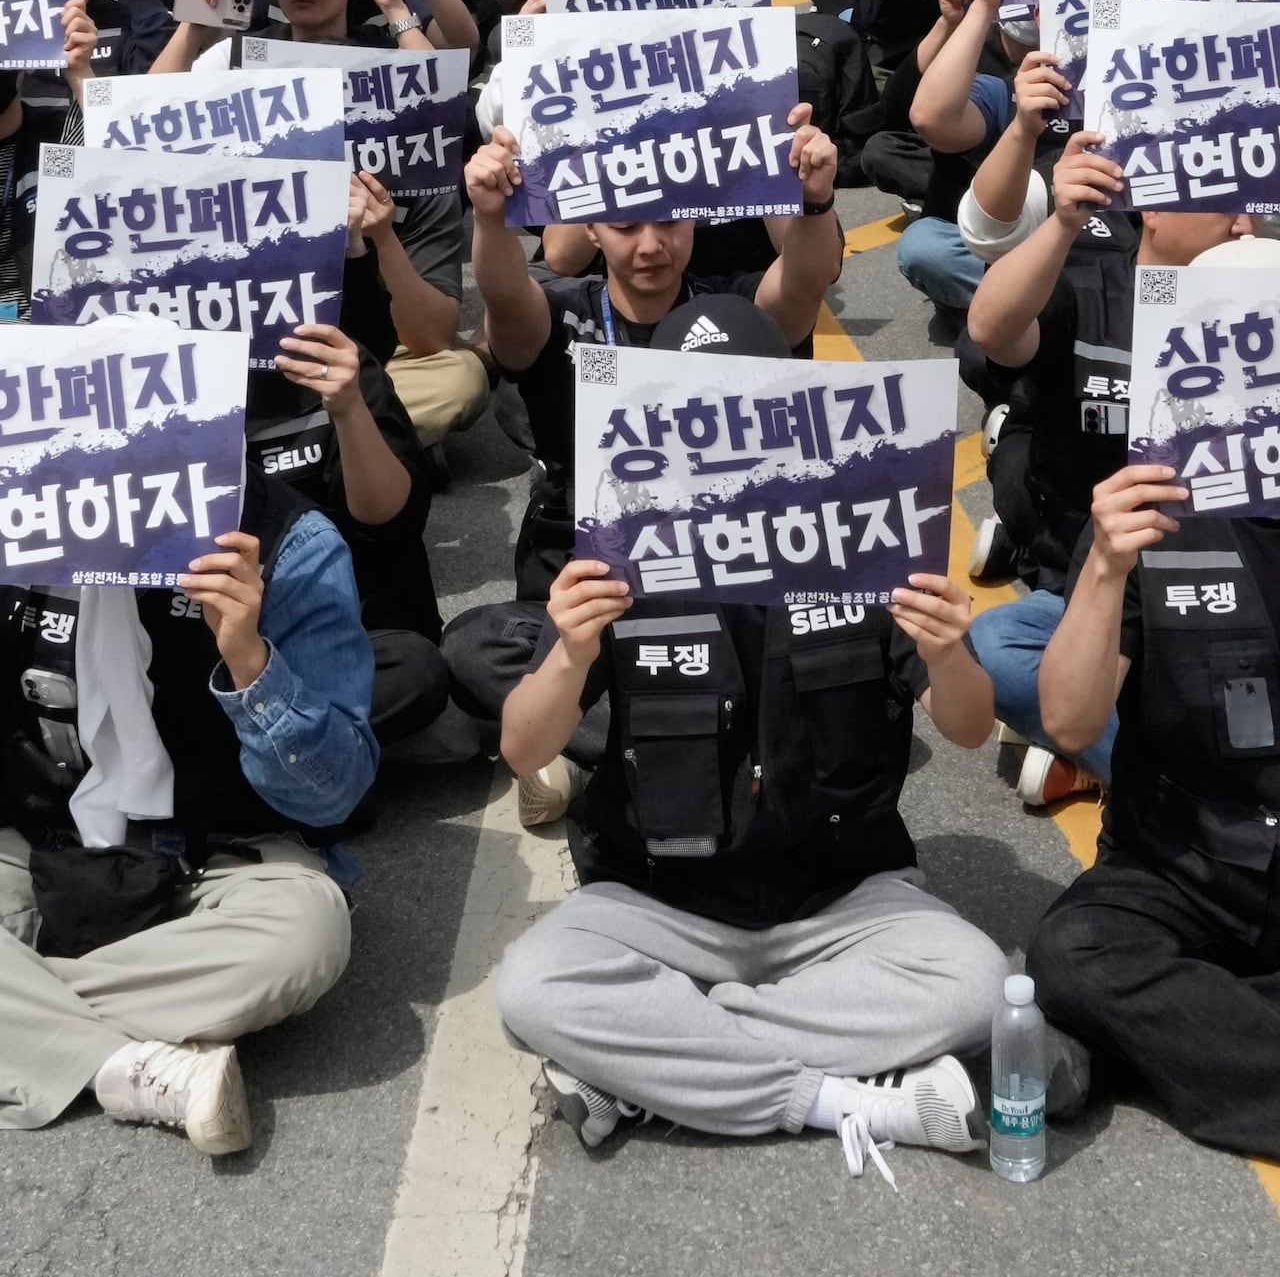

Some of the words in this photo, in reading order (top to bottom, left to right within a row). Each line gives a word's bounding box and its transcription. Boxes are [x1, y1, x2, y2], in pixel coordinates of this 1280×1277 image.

[520, 17, 760, 125] 상한폐지
[548, 113, 795, 221] 실현하자
[55, 171, 309, 260] 상한폐지
[671, 206, 744, 218] 삼성전자노동조합
[745, 203, 801, 216] 공동투쟁본부
[681, 331, 729, 352] adidas
[599, 374, 907, 483] 상한폐지
[628, 487, 950, 594] 실현하자
[72, 571, 162, 585] 삼성전자노동조합
[783, 591, 876, 605] 삼성전자노동조합
[1166, 582, 1237, 615] 투쟁
[791, 604, 865, 635] SELU
[636, 643, 710, 676] 투쟁
